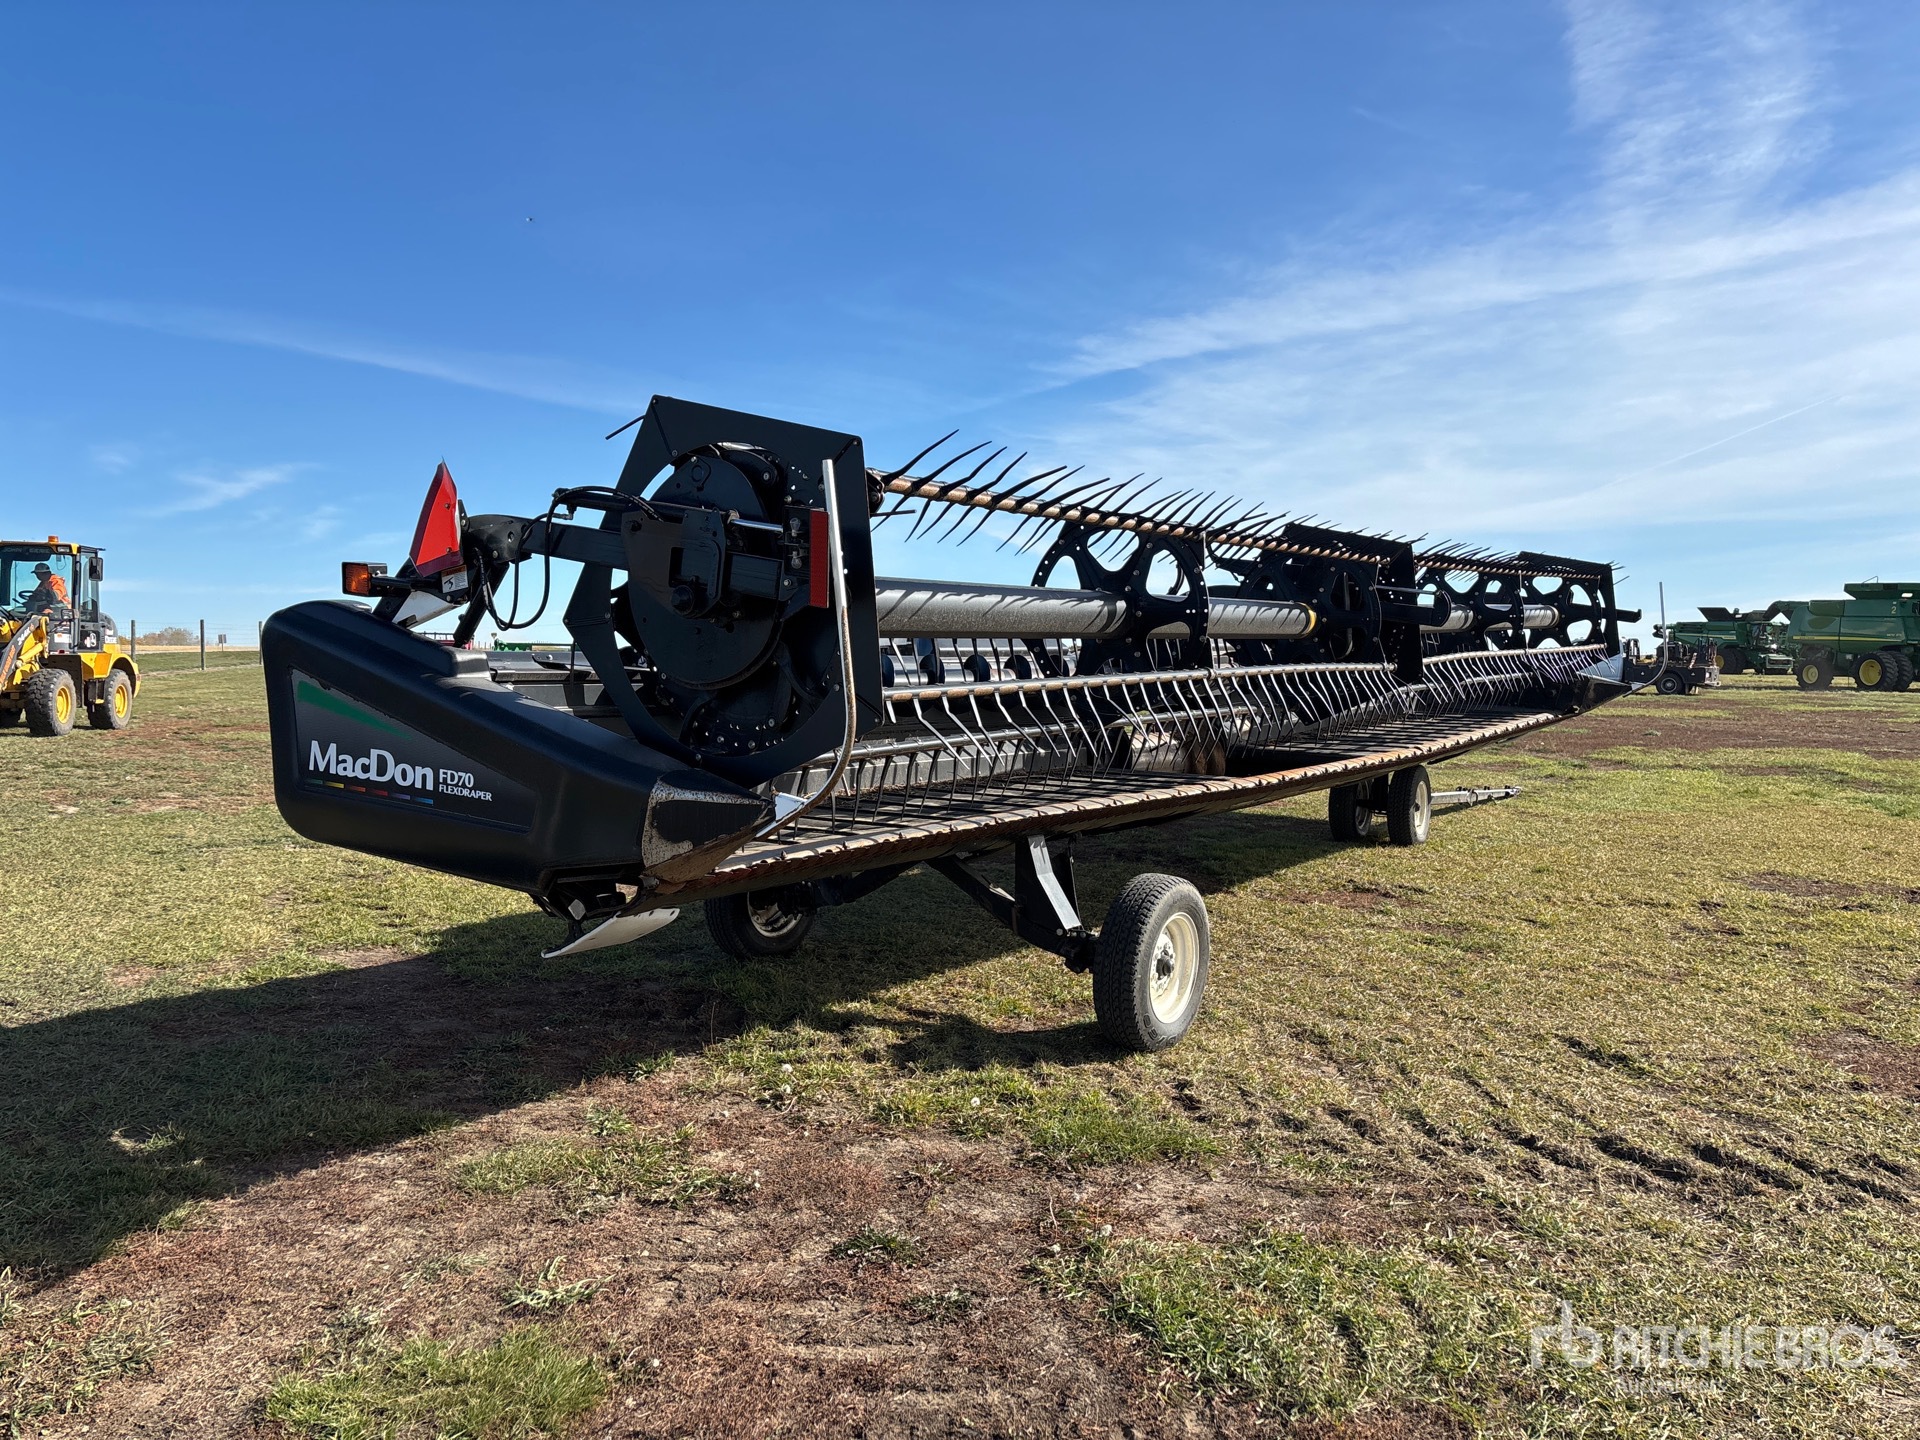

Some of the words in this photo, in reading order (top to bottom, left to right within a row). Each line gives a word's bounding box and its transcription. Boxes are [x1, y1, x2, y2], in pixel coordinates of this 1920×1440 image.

[1891, 606, 1897, 614] 2
[308, 740, 434, 791] MacDon
[439, 768, 474, 788] FD70
[439, 784, 492, 802] FLEXDRAPER
